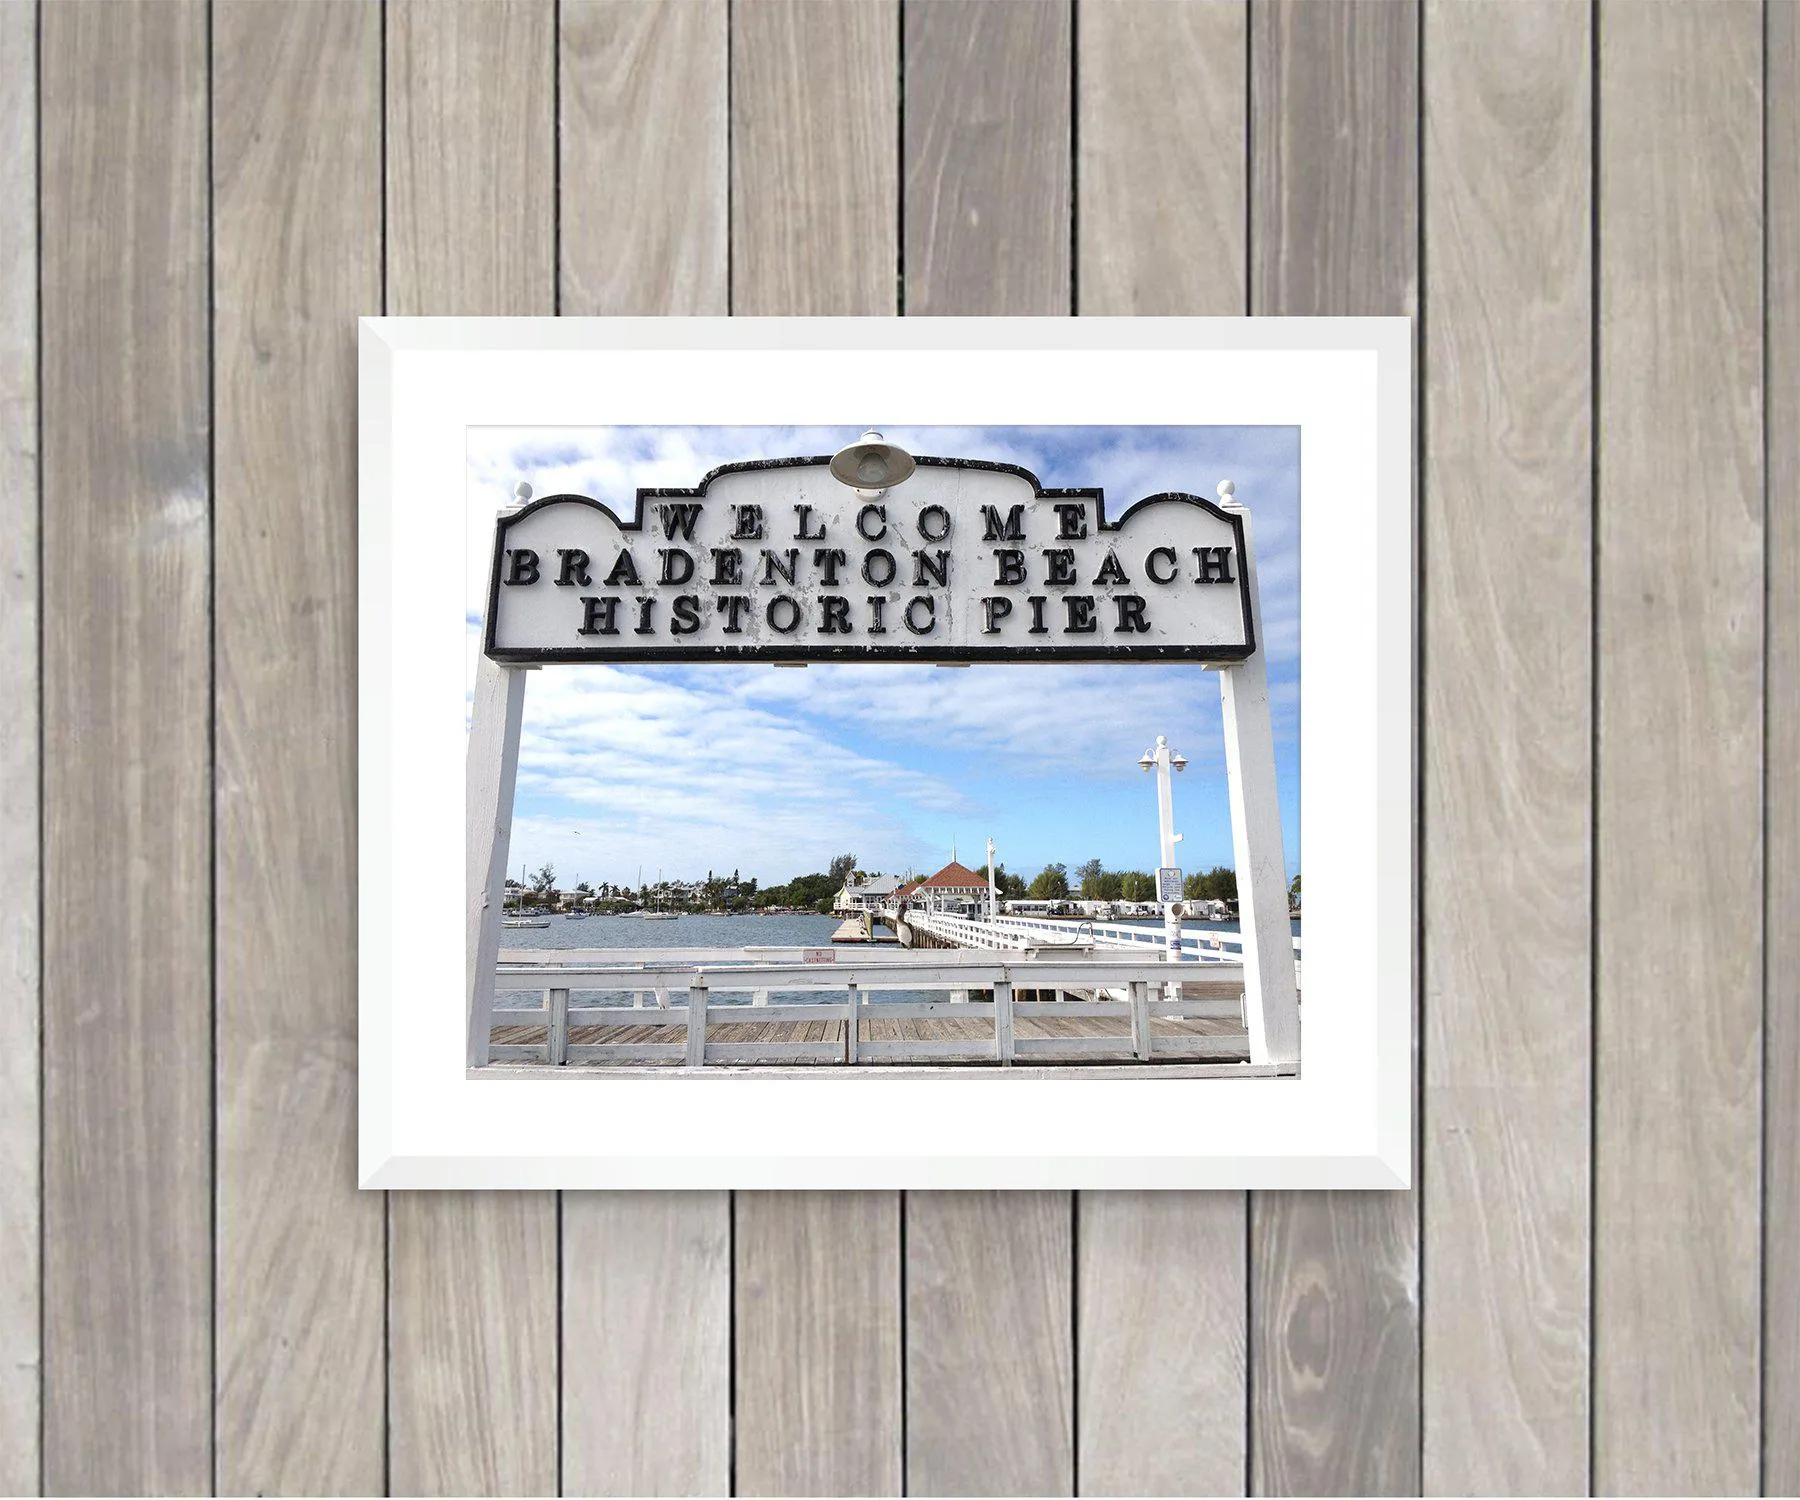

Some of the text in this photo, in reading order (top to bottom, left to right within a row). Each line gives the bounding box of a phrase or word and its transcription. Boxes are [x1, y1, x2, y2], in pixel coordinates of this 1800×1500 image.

[655, 503, 1087, 542] WELCOME
[503, 546, 1237, 588] BRADENTON BEACH
[577, 594, 1152, 635] HISTORIC PIER
